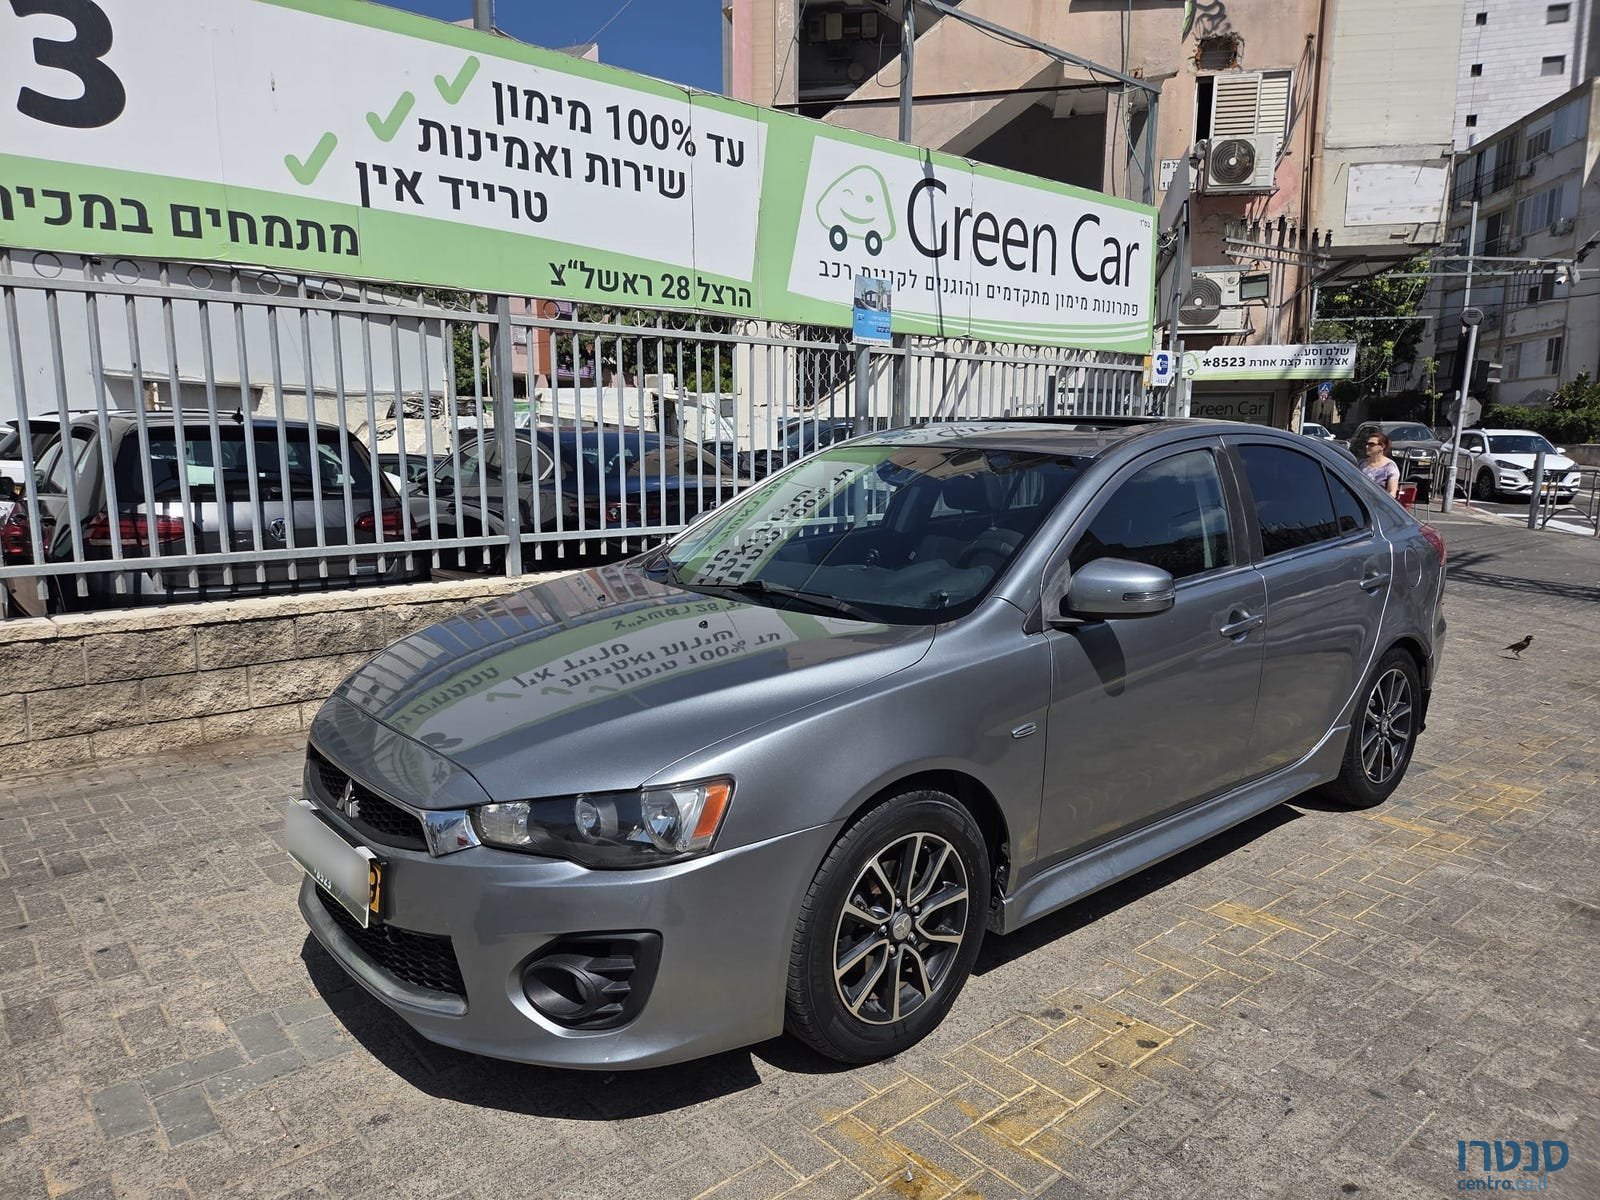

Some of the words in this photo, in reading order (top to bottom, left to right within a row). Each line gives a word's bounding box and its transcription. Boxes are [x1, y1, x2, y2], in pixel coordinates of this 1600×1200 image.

[9, 0, 126, 129] 3
[492, 81, 591, 134] מימון
[606, 104, 697, 157] 100%
[418, 118, 572, 179] ואמינות
[706, 132, 744, 168] עד
[355, 161, 424, 208] אין
[585, 152, 686, 200] שירות
[439, 175, 548, 223] טרייד
[170, 203, 359, 256] מתמחים
[907, 177, 1057, 276] Green
[1072, 213, 1140, 287] Car
[818, 259, 852, 280] רכב
[660, 273, 690, 301] 28
[697, 276, 752, 308] הרצל
[925, 275, 979, 297] והוגנים
[986, 284, 1050, 307] מתקדמים
[1056, 293, 1088, 311] מימון
[1092, 298, 1139, 317] פתרונות
[1248, 358, 1278, 367] אחרת
[1280, 358, 1302, 369] קצת
[1304, 358, 1317, 366] זה
[1319, 356, 1349, 366] אצלנו
[1325, 346, 1350, 356] שלם
[1190, 401, 1234, 416] Green
[1237, 400, 1265, 415] Car
